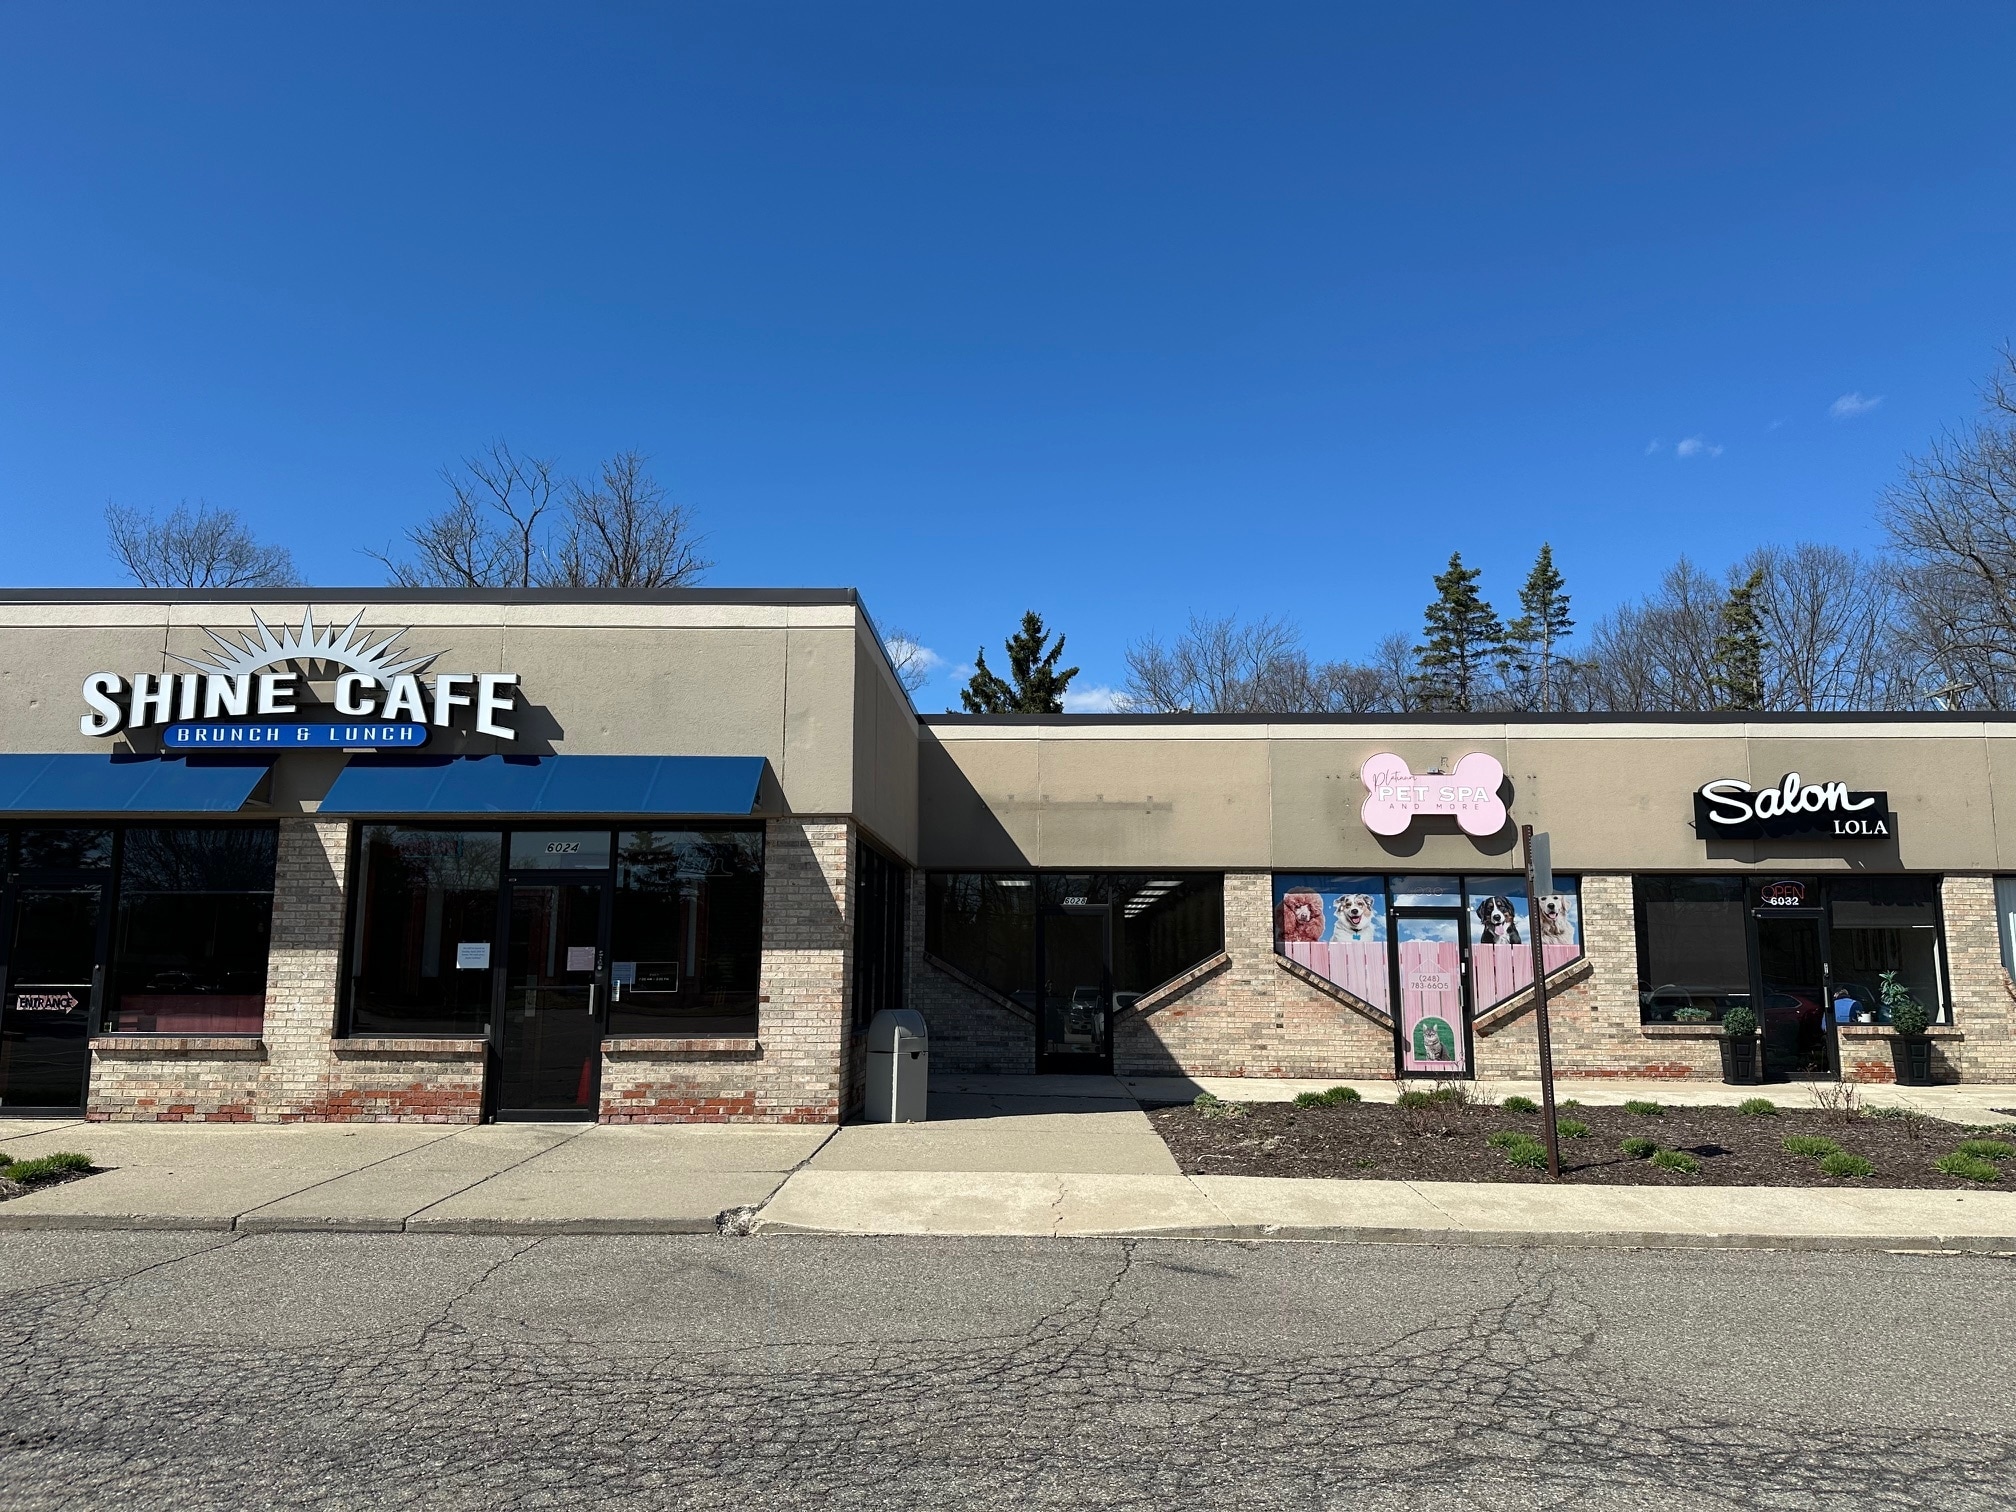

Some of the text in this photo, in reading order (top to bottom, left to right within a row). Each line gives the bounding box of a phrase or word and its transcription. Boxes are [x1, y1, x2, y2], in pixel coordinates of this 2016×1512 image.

[79, 671, 518, 740] SHINE CAFE
[177, 727, 413, 741] BRUNCH & LUNCH
[1378, 785, 1491, 803] PET SPA
[1702, 772, 1875, 824] Salon
[1436, 803, 1480, 811] MORE
[1833, 820, 1888, 834] LOLA
[547, 842, 580, 852] 6024
[1761, 885, 1804, 899] OPEN
[1770, 896, 1799, 906] 6032
[1419, 974, 1440, 983] (248)
[20, 997, 73, 1008] ENTRANCE
